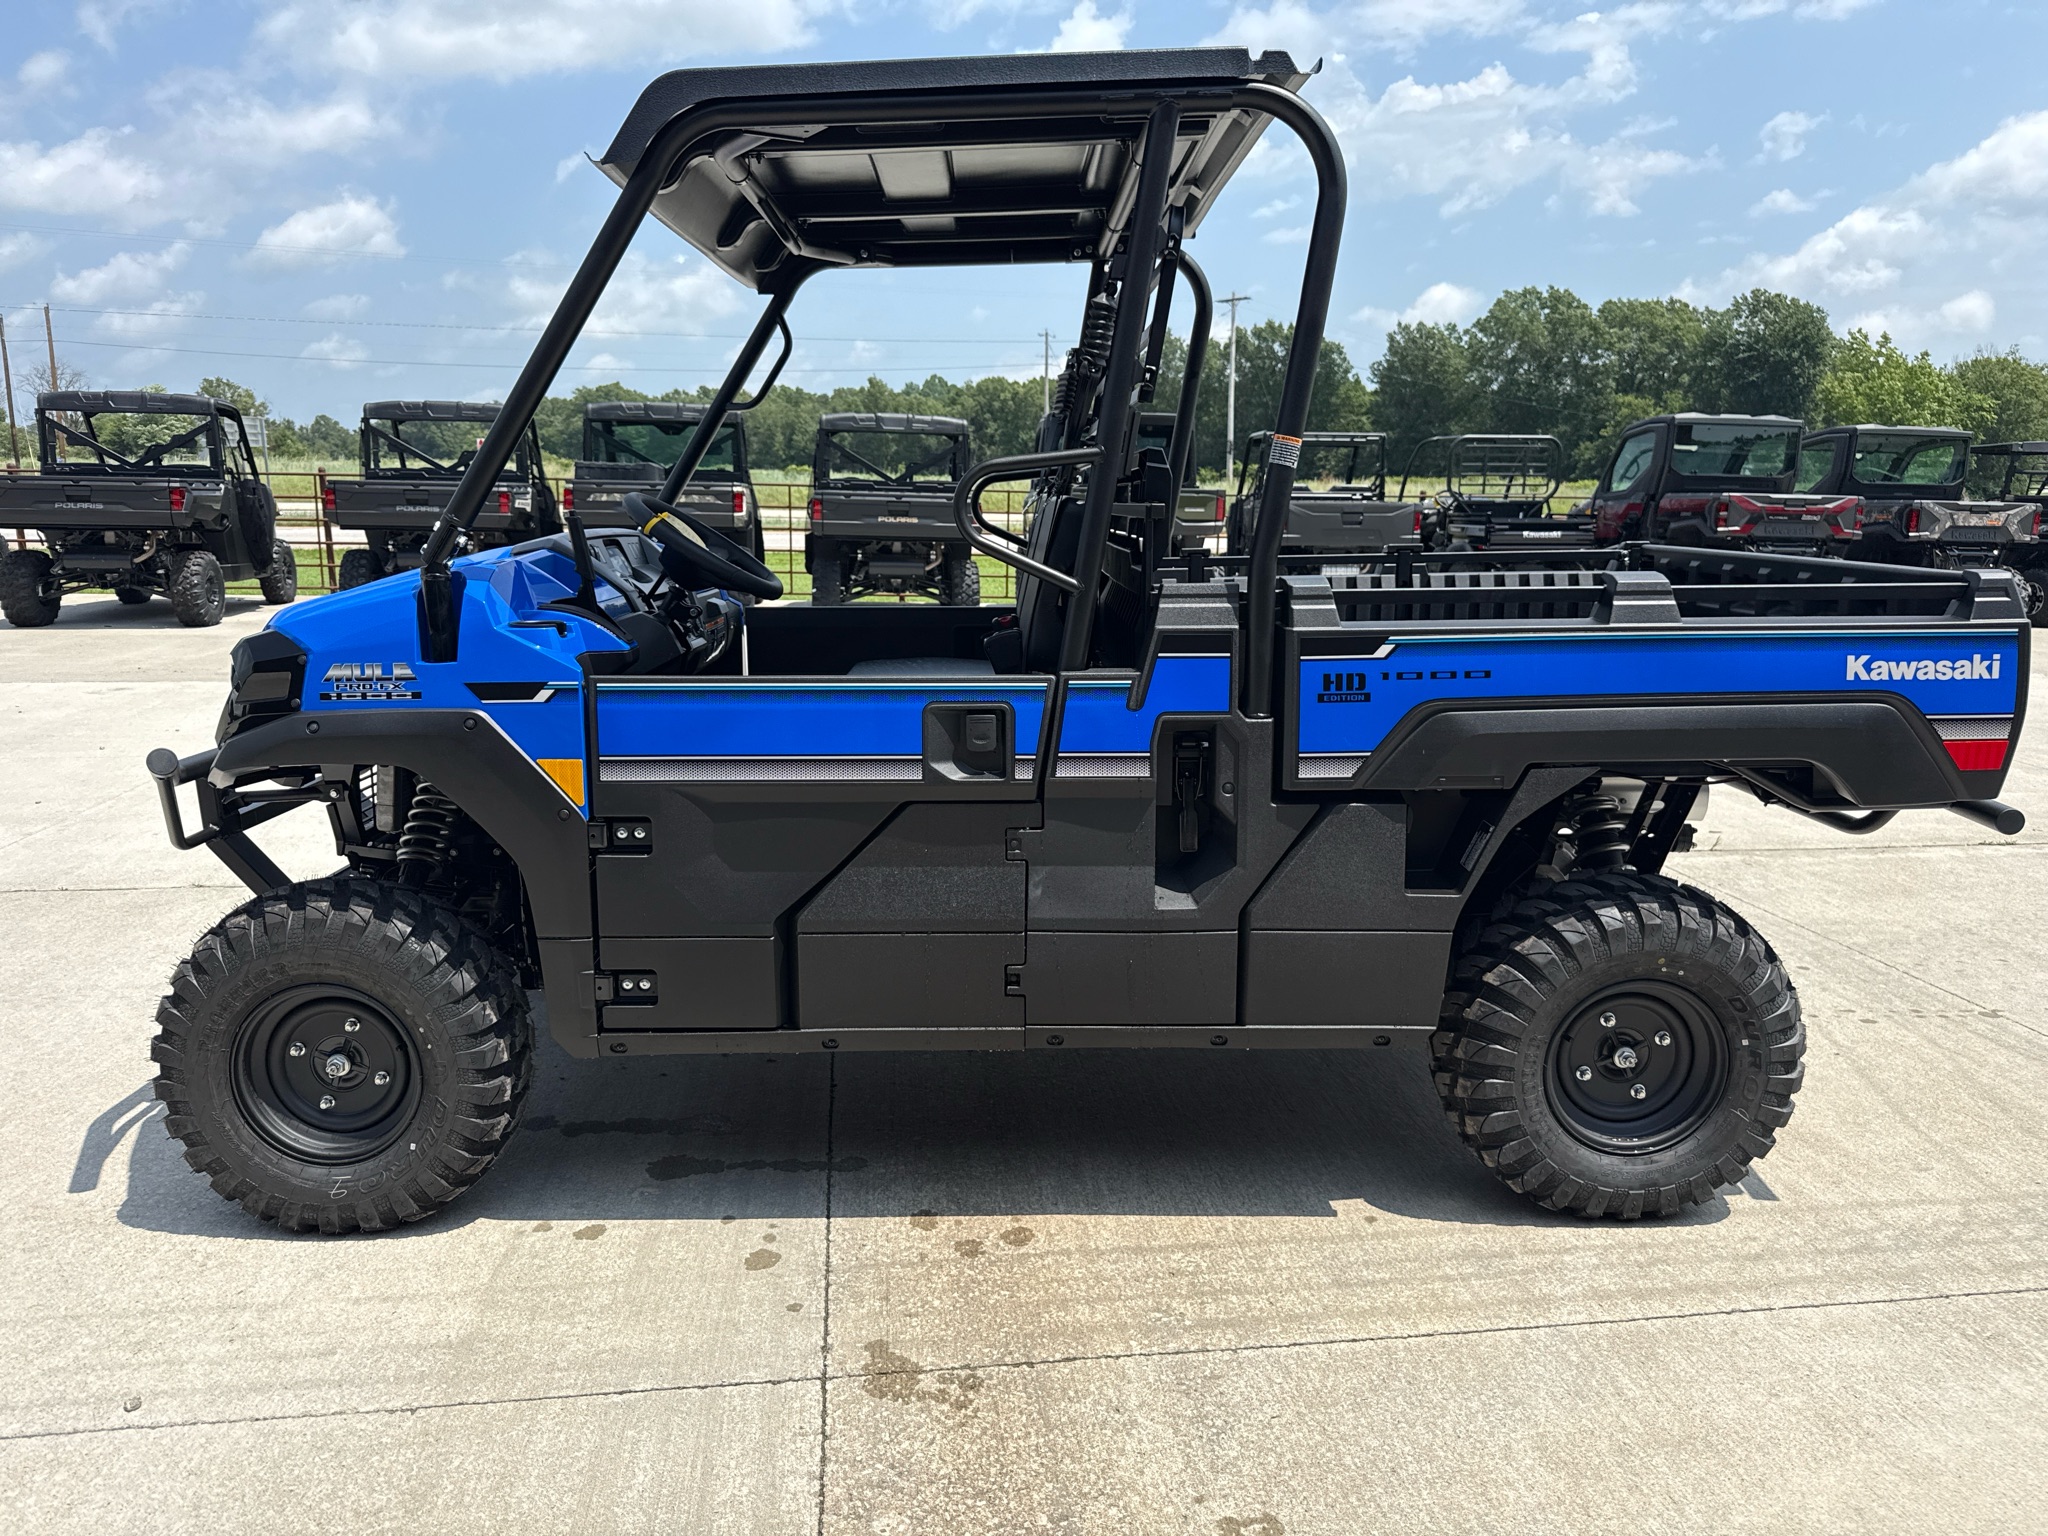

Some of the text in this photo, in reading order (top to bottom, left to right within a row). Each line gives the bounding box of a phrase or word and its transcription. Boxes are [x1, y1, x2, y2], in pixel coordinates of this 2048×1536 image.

[1522, 531, 1561, 539] Kawasaki
[321, 662, 419, 683] MULE
[1846, 653, 2001, 681] Kawasaki
[1322, 670, 1492, 692] HD 1000
[329, 691, 413, 701] 1000
[1322, 693, 1367, 702] EDITION
[1725, 994, 1764, 1101] DURO
[358, 1095, 449, 1194] DURO
